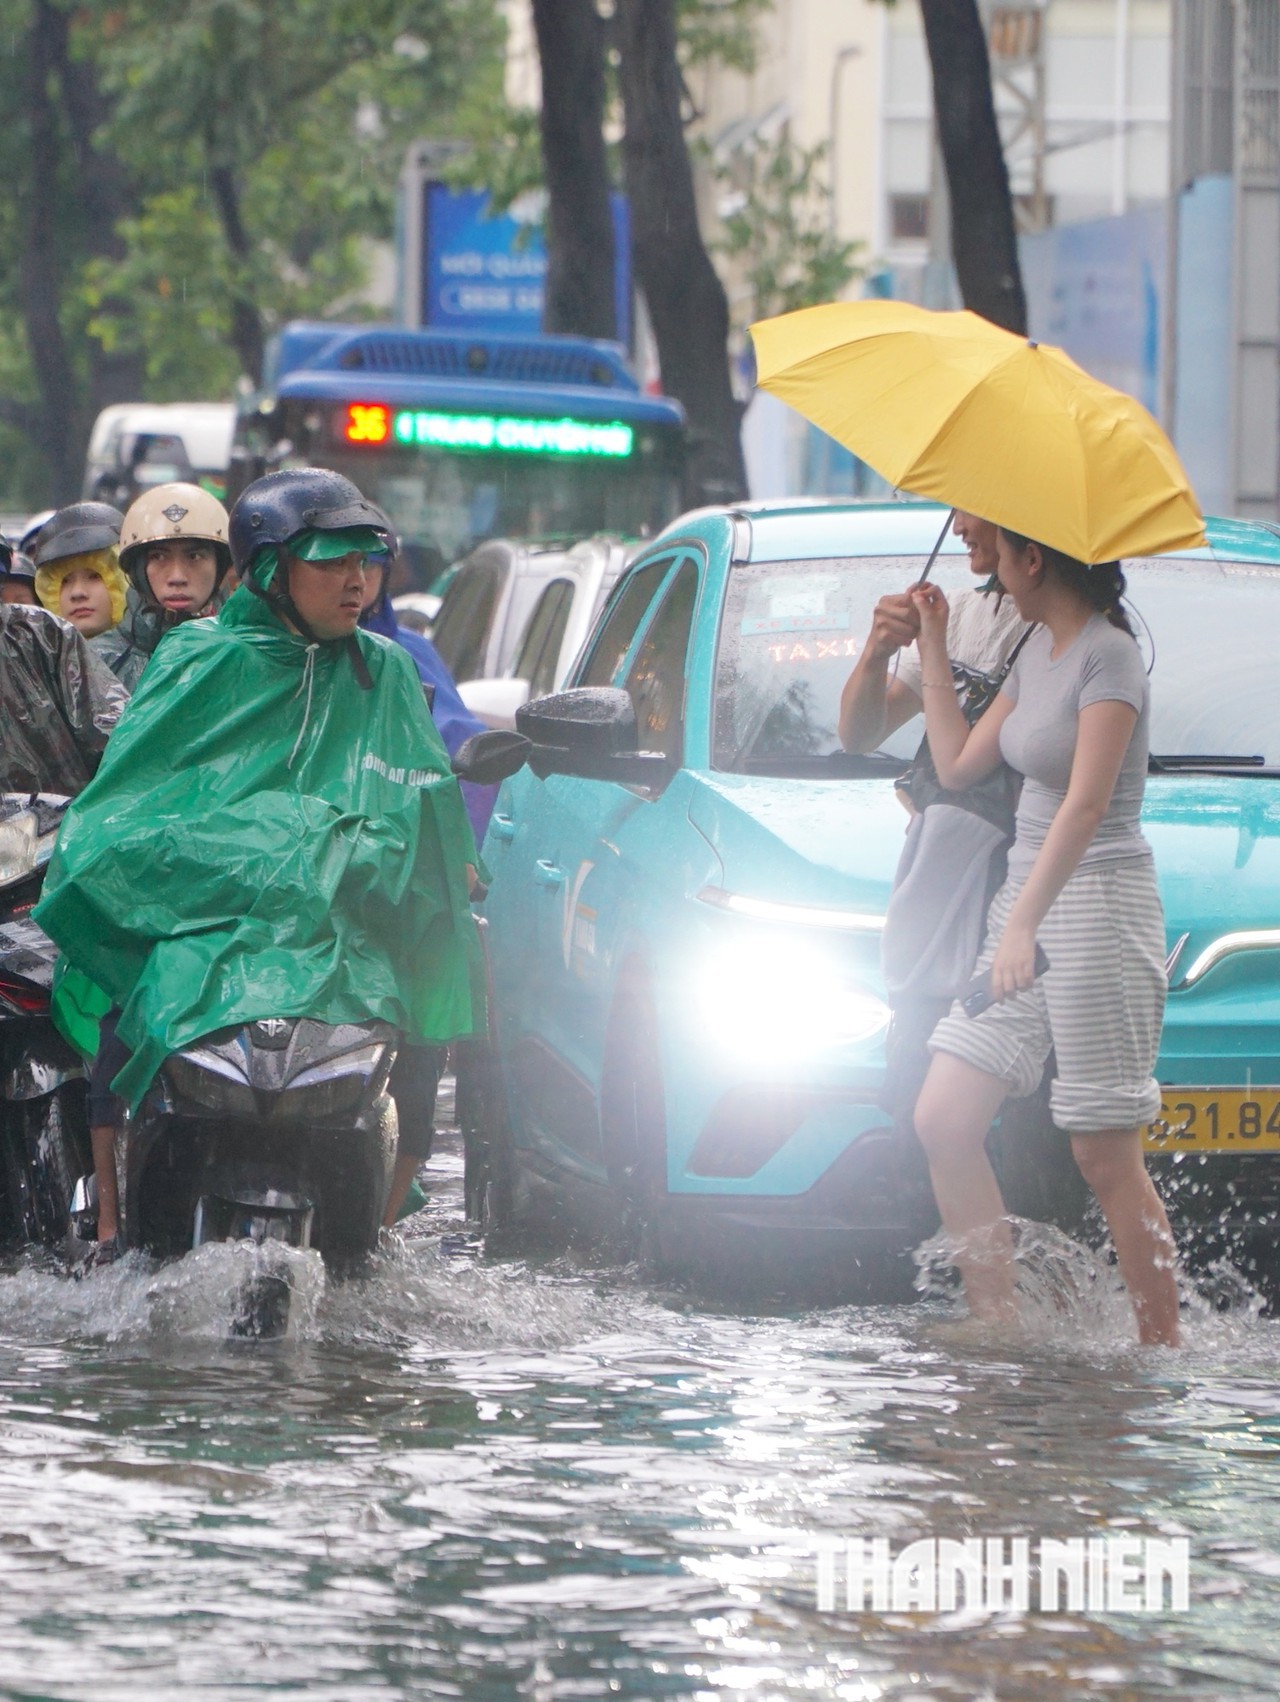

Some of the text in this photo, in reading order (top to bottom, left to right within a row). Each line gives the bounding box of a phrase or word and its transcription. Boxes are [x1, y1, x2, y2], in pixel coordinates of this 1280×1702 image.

[346, 403, 388, 442] 36
[791, 618, 836, 627] TAXI
[768, 638, 857, 662] TAXI
[388, 767, 405, 785] AN
